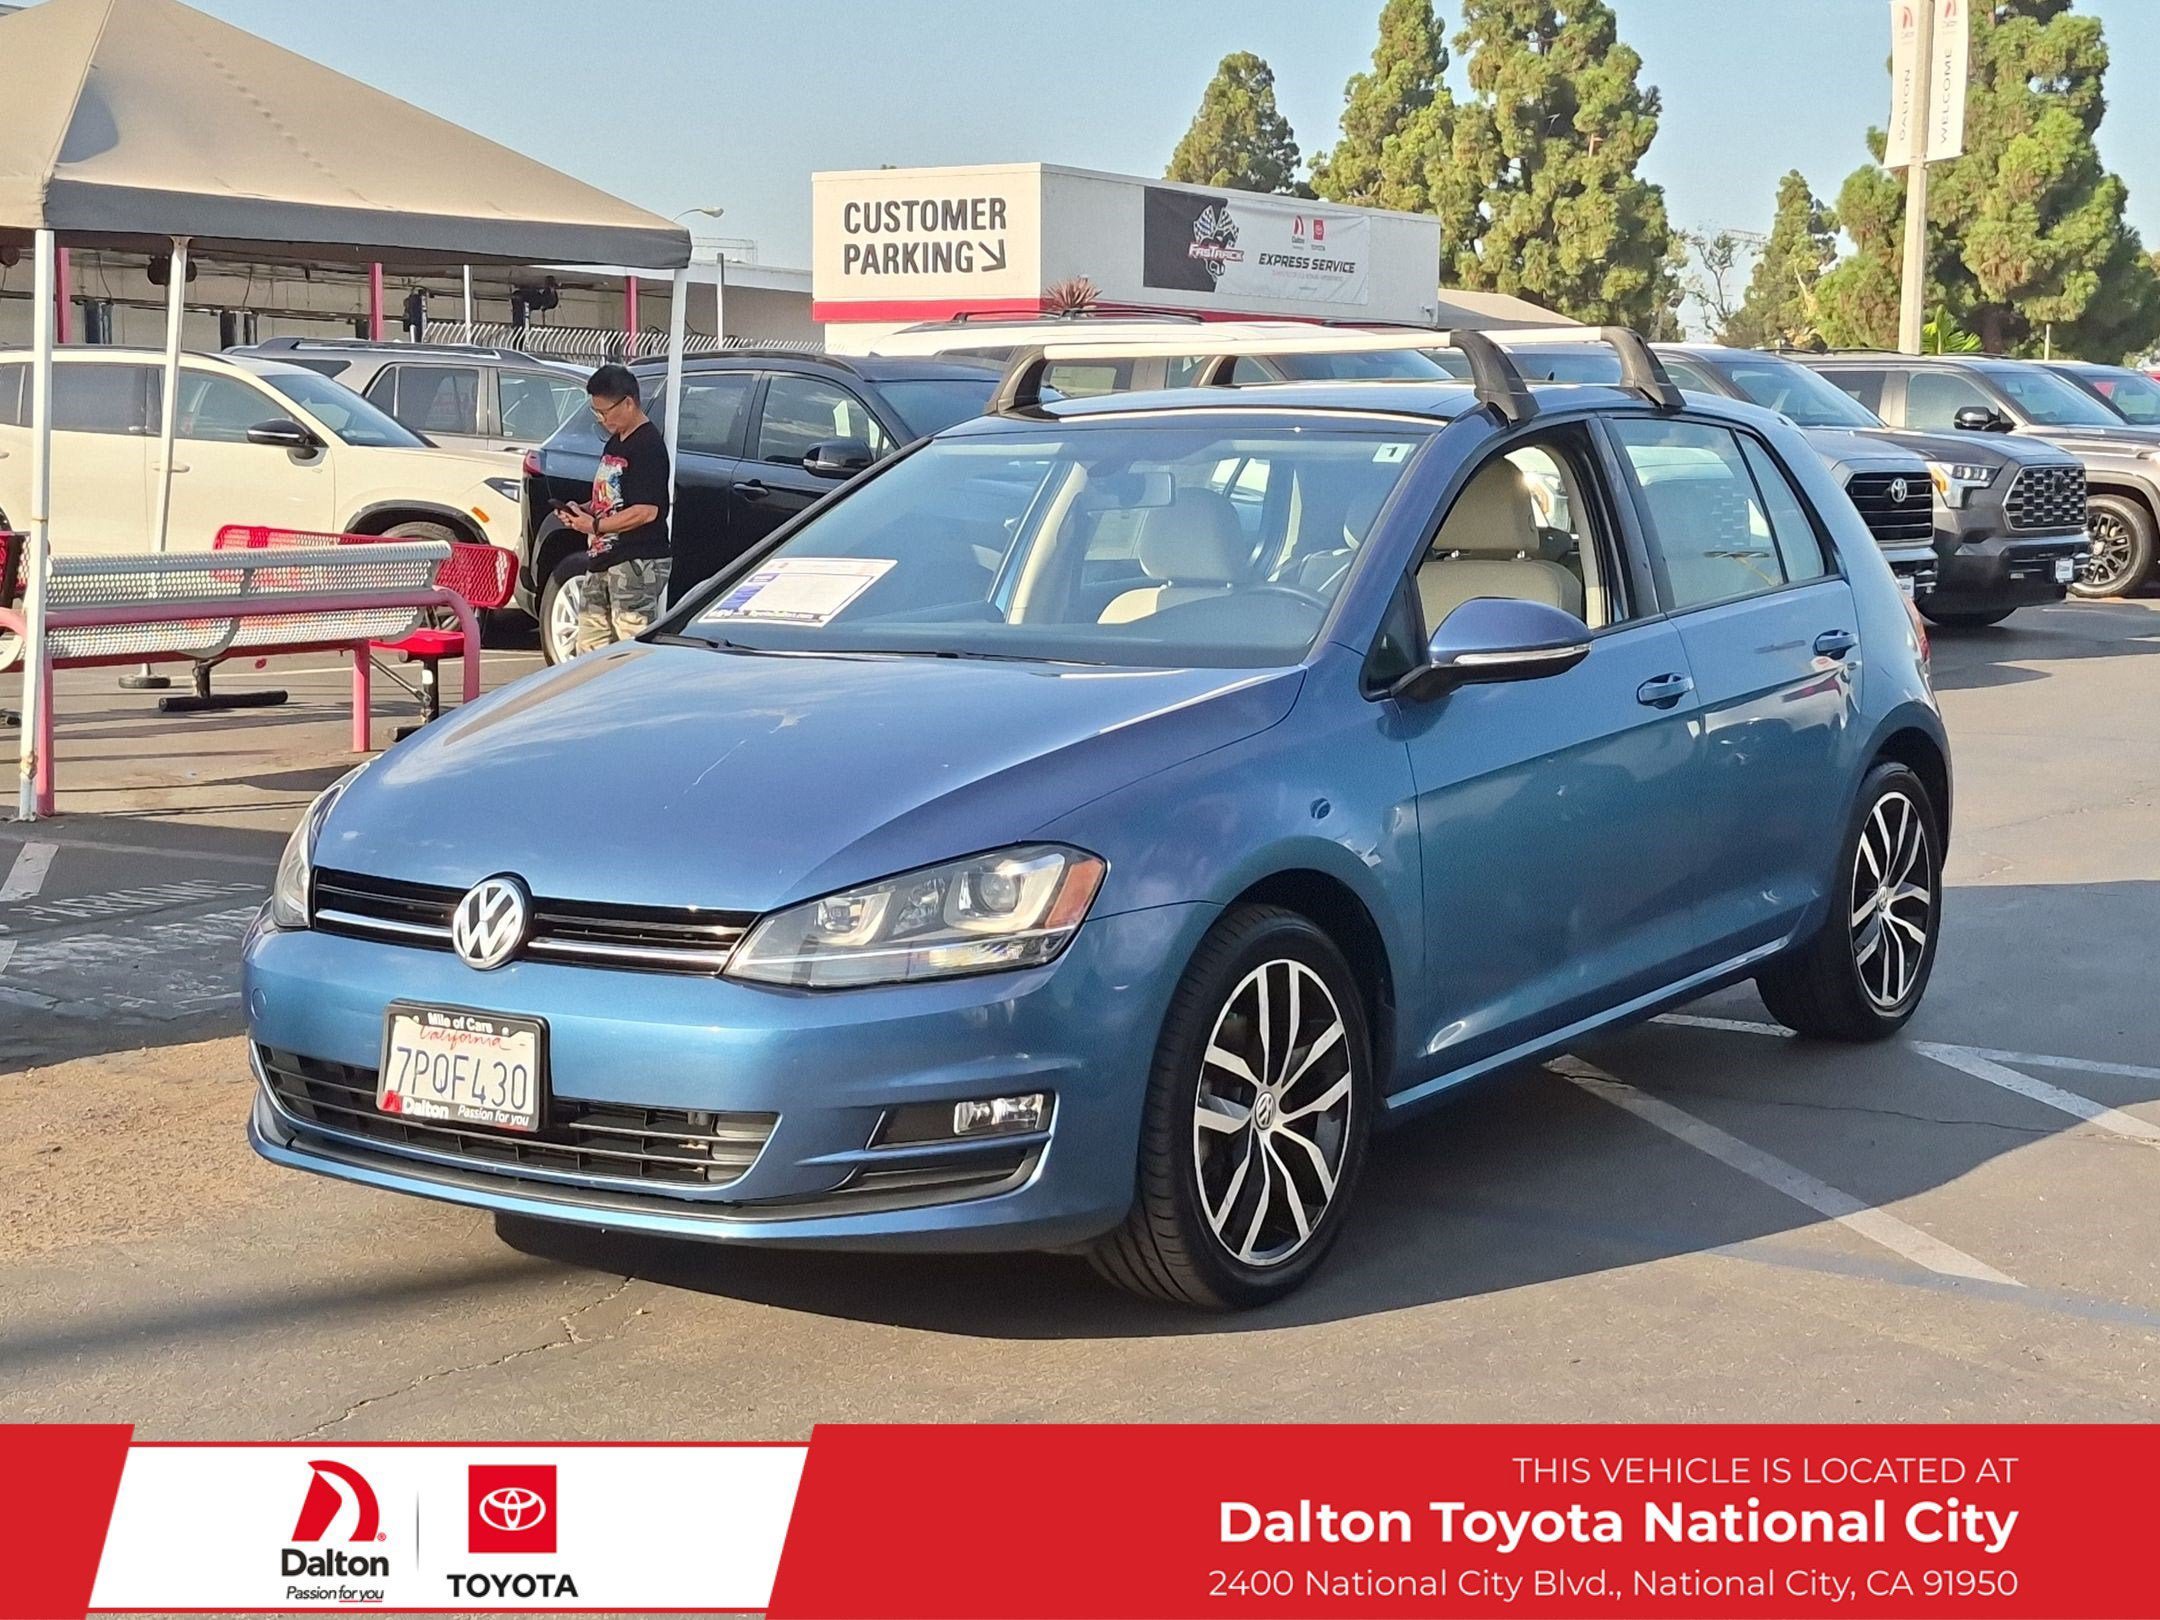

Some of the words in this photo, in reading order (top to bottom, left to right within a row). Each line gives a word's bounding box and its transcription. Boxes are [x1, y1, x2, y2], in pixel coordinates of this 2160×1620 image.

[1940, 48, 1953, 144] WELCOME
[844, 197, 1007, 234] CUSTOMER
[844, 240, 973, 275] PARKING
[1258, 252, 1310, 269] EXPRESS
[1311, 258, 1356, 274] SERVICE
[419, 1025, 511, 1051] California
[427, 1012, 451, 1028] Mile
[452, 1016, 465, 1029] of
[466, 1019, 493, 1034] Cars
[402, 1096, 449, 1120] Dalton
[458, 1105, 493, 1122] Passion
[494, 1110, 510, 1124] for
[510, 1113, 530, 1126] you
